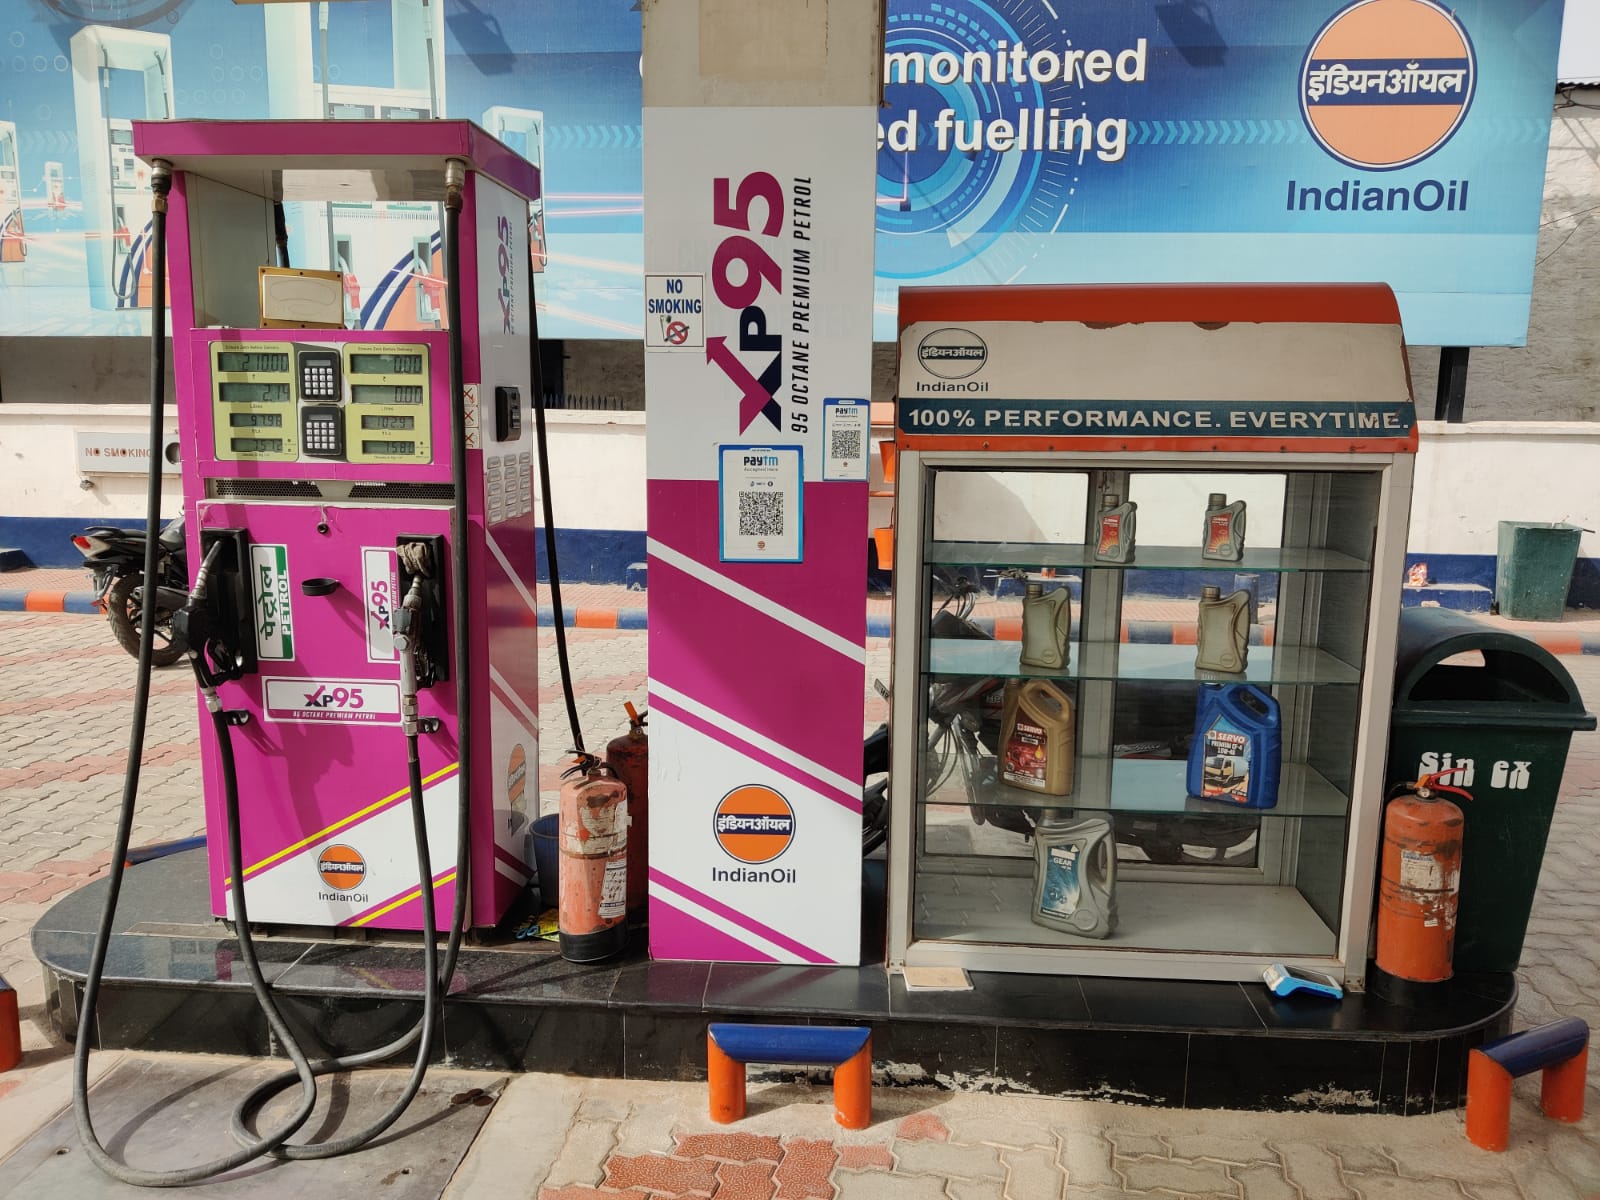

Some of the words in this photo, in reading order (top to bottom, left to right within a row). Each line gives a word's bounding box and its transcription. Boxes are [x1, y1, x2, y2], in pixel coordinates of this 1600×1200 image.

[884, 38, 1148, 84] monitored
[1308, 62, 1467, 102] इंडियनऑयल
[934, 108, 1128, 162] fuelling
[1286, 180, 1470, 212] IndianOil
[793, 176, 812, 241] PETROL
[666, 279, 683, 294] NO
[792, 249, 811, 333] PREMIUM
[648, 298, 702, 314] SMOKING
[706, 171, 785, 436] XP95
[791, 342, 809, 405] OCTANE
[916, 381, 989, 392] IndianOil
[791, 412, 808, 433] 95
[908, 408, 976, 428] 100%
[984, 410, 1221, 428] PERFORMANCE.
[1230, 411, 1409, 429] EVERYTIME.
[85, 447, 101, 456] NO
[258, 564, 277, 640] पेट्रोल
[278, 570, 292, 635] PETROL
[370, 580, 390, 631] XP95
[304, 685, 364, 709] XP95
[1218, 733, 1246, 743] SERVO
[717, 815, 791, 832] इंडियनऑयल
[1054, 857, 1073, 867] GEAR
[712, 867, 796, 883] IndianOil
[318, 892, 369, 903] IndianOil
